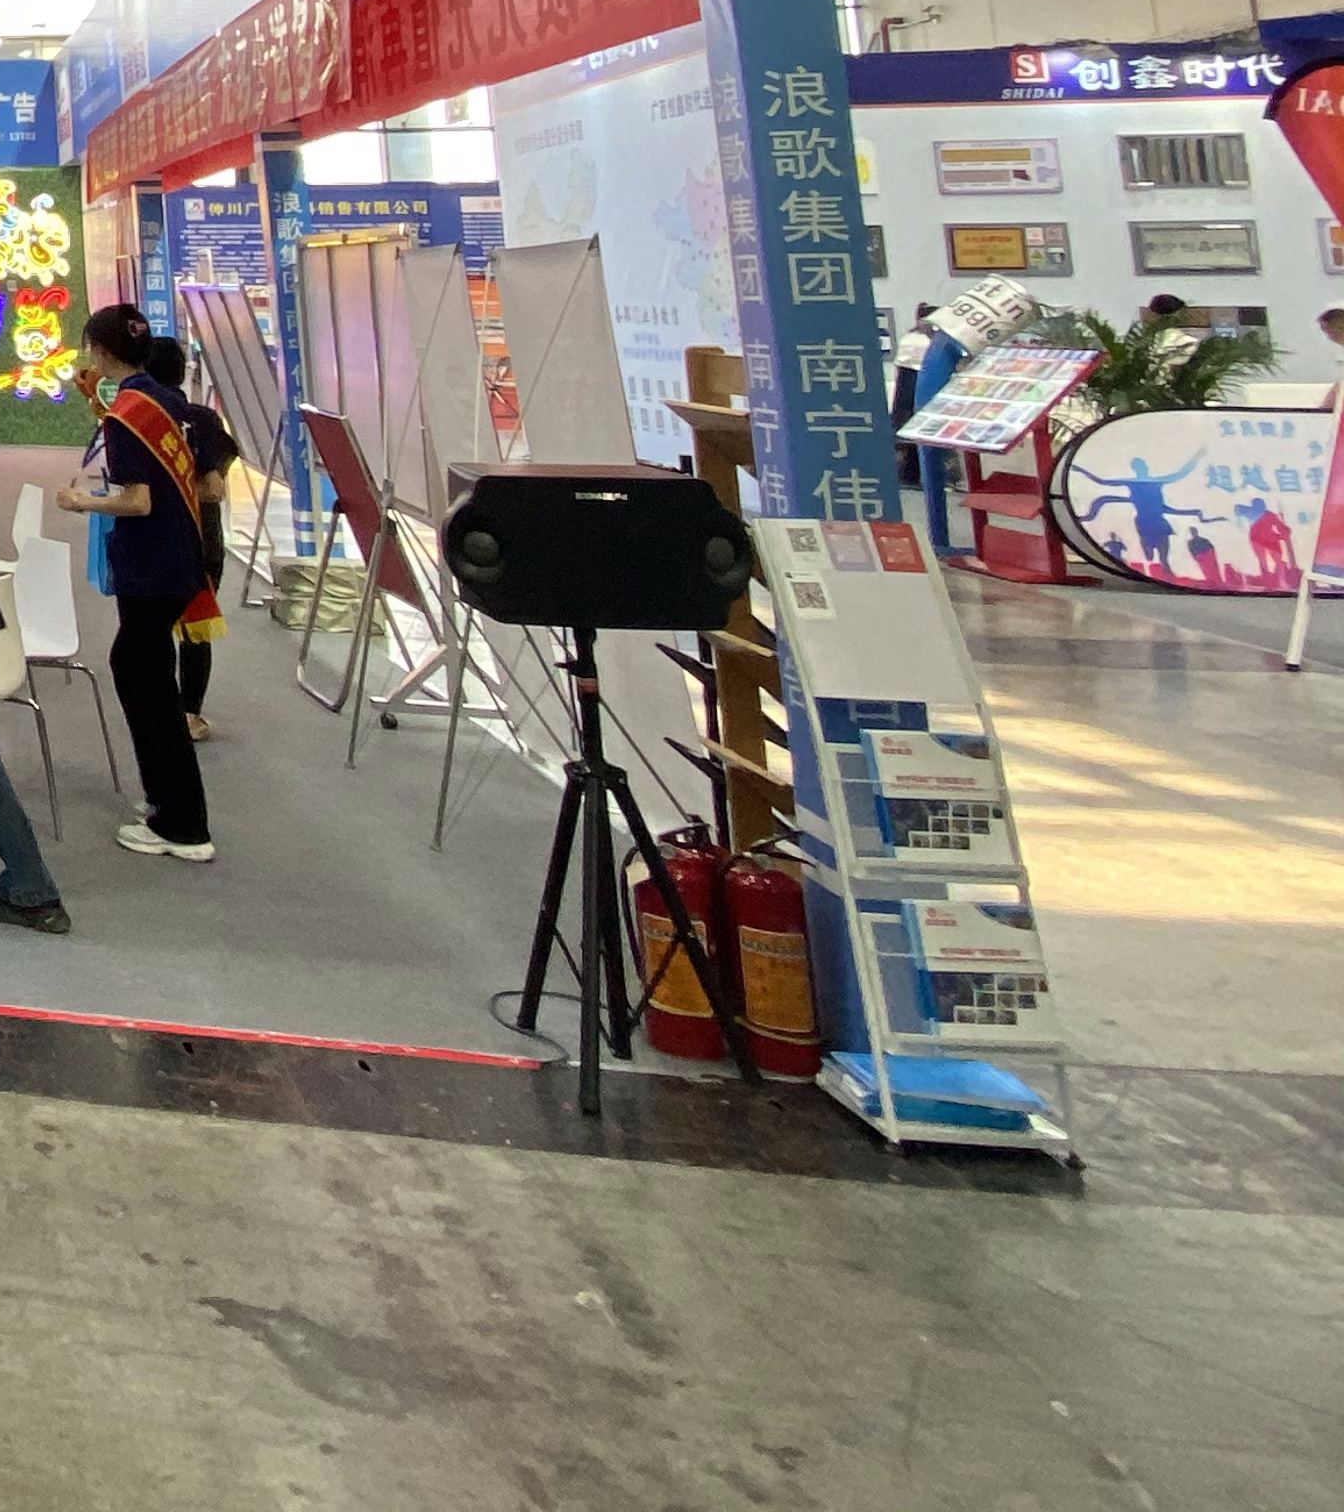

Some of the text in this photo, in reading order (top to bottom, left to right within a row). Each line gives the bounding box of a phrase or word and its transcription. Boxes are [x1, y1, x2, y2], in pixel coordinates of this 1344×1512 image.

[1068, 53, 1287, 91] 创鑫时代
[761, 64, 857, 306] 浪歌集团
